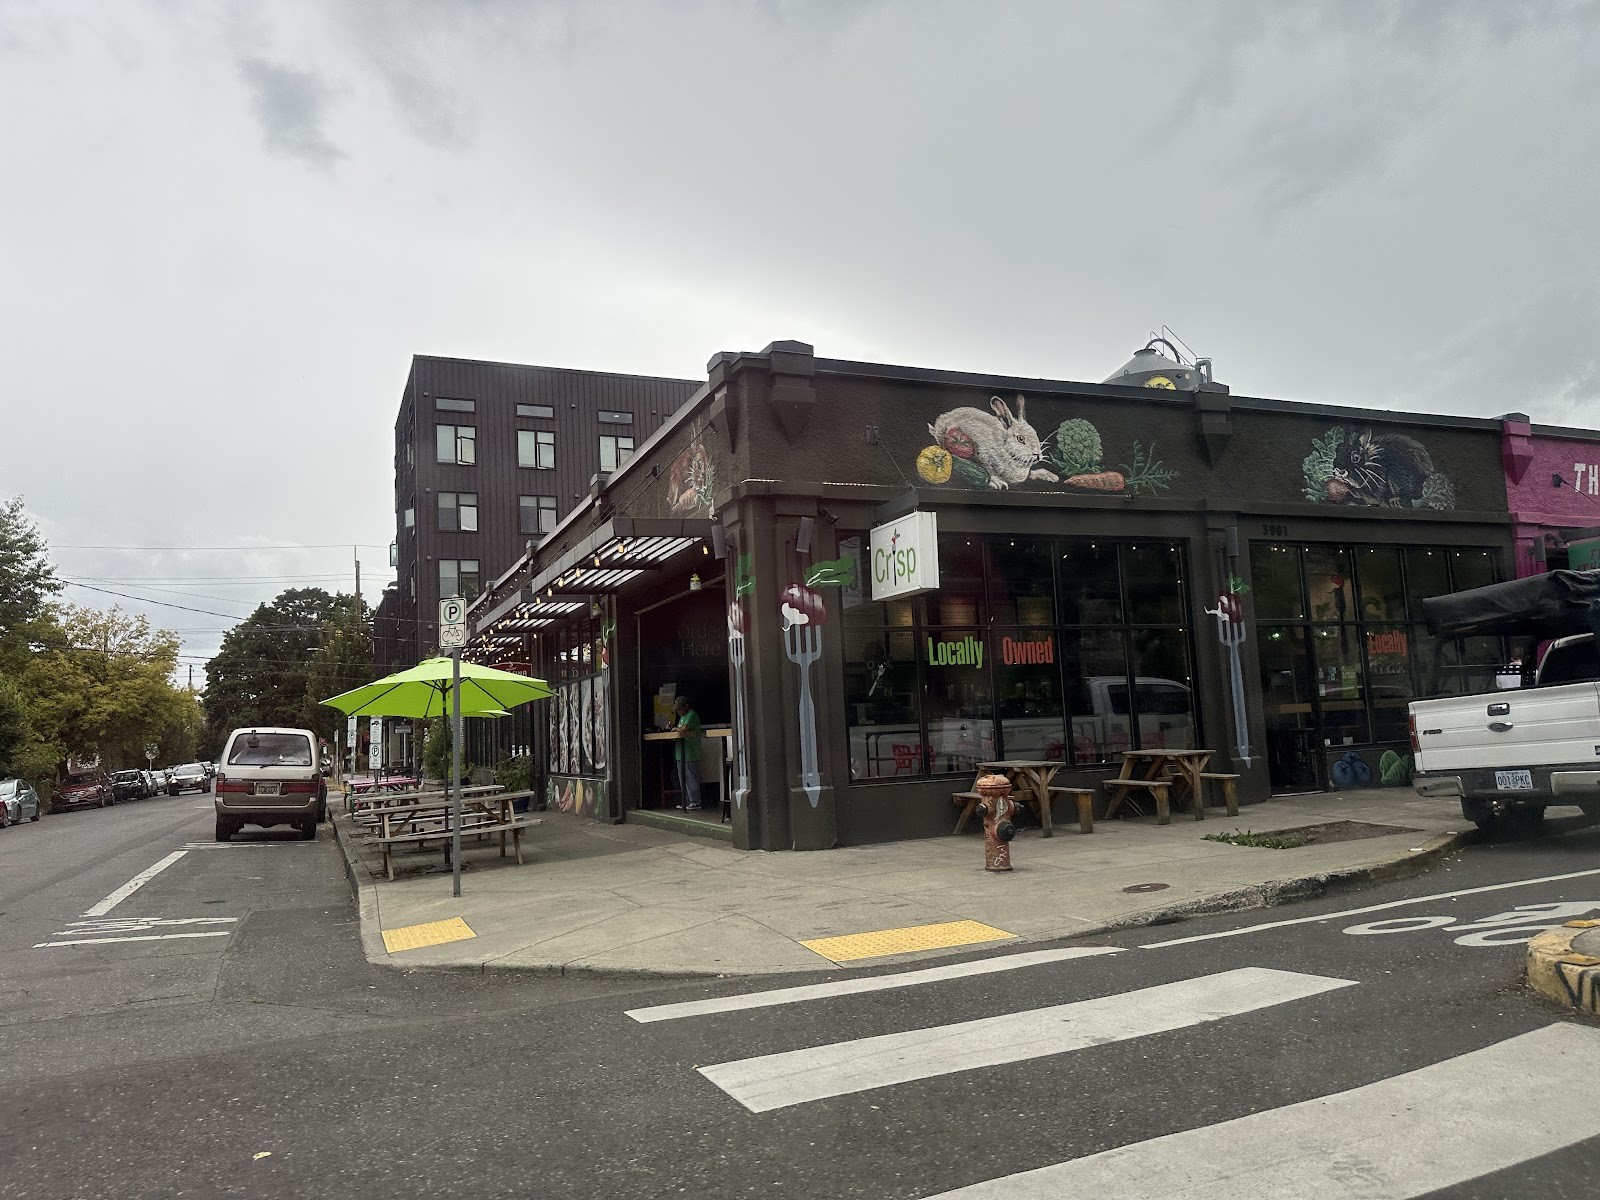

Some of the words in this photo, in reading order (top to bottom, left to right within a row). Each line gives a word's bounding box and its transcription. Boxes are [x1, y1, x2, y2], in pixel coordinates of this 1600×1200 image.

[875, 529, 917, 586] Crisp
[449, 606, 457, 619] P
[681, 640, 721, 657] Here
[928, 636, 983, 669] Locally
[1002, 637, 1055, 666] Owned
[1368, 629, 1407, 657] Locally
